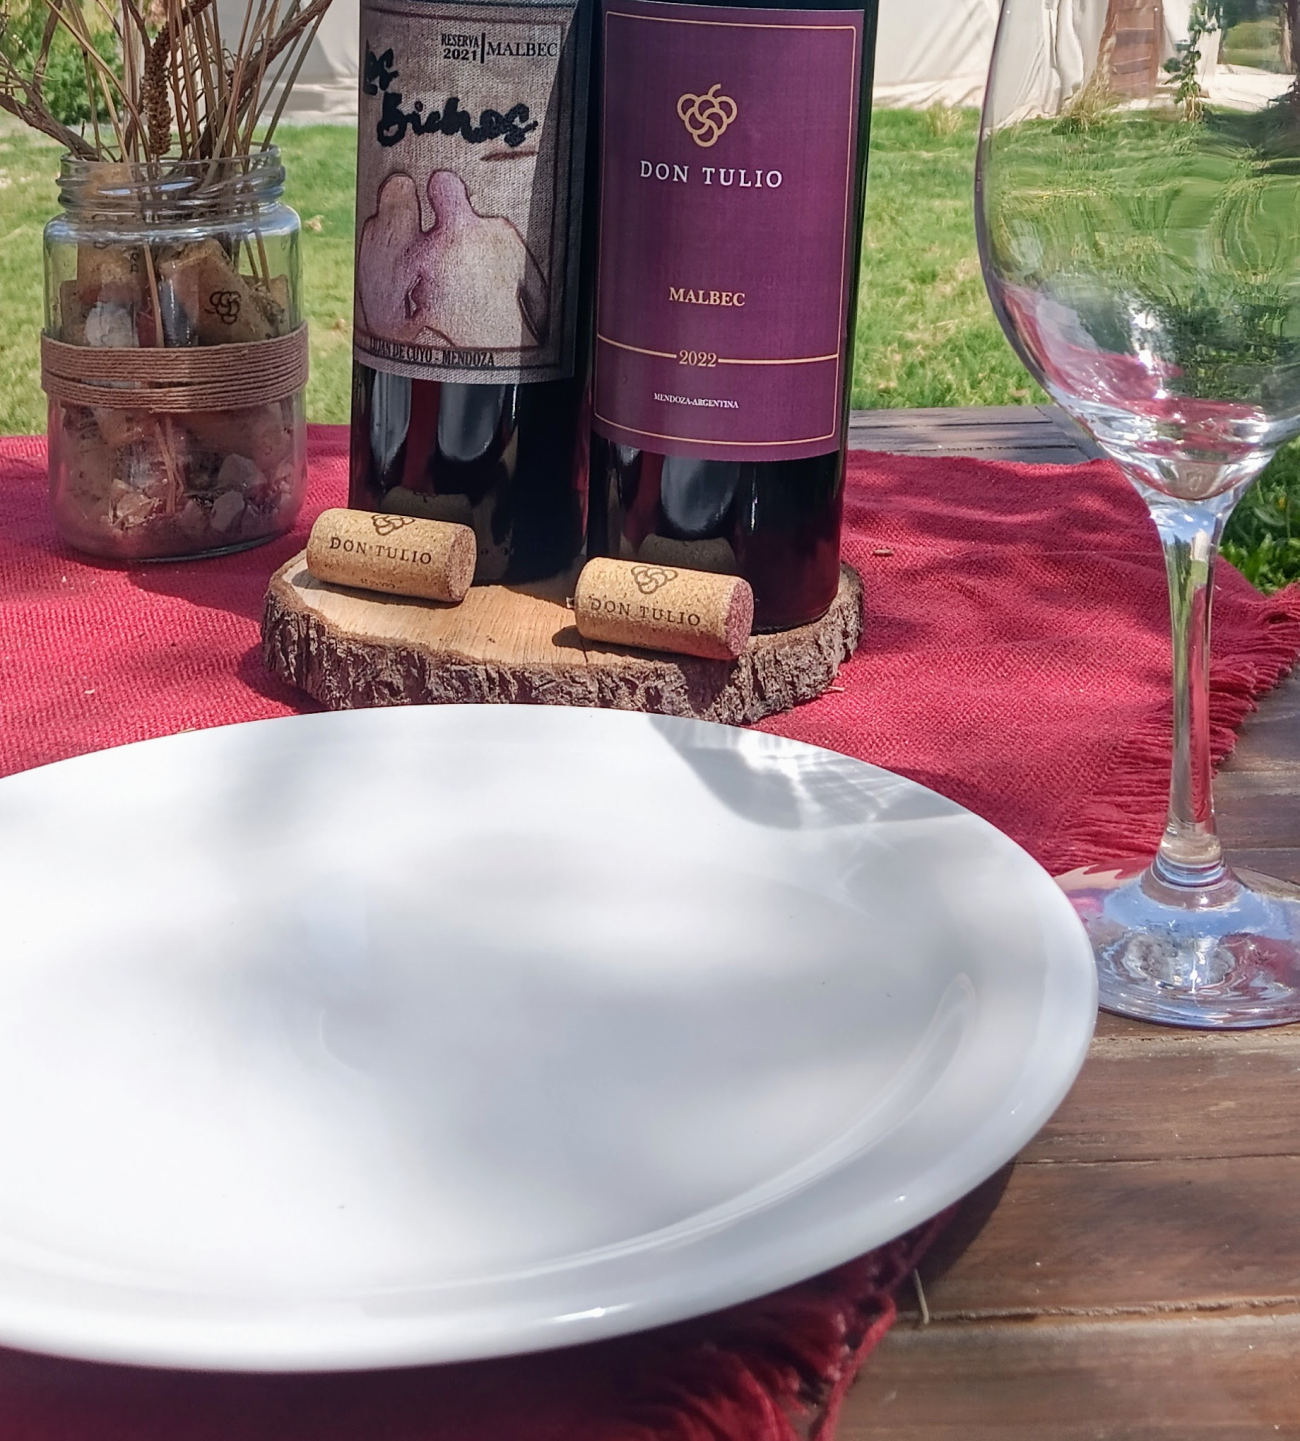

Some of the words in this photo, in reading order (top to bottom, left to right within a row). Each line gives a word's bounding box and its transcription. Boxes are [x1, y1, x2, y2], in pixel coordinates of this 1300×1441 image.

[441, 33, 479, 47] RESERVA
[486, 41, 558, 57] MALBEC
[443, 48, 477, 61] 2021
[640, 160, 689, 183] DON
[702, 167, 783, 188] TULIO
[669, 286, 746, 307] MALBEC
[407, 345, 433, 362] CUYO
[442, 349, 495, 366] MENDOZA
[679, 350, 717, 367] 2022
[329, 536, 367, 555] DON
[375, 545, 433, 565] TULIO
[590, 597, 631, 616] DON
[640, 605, 701, 627] TULIO
